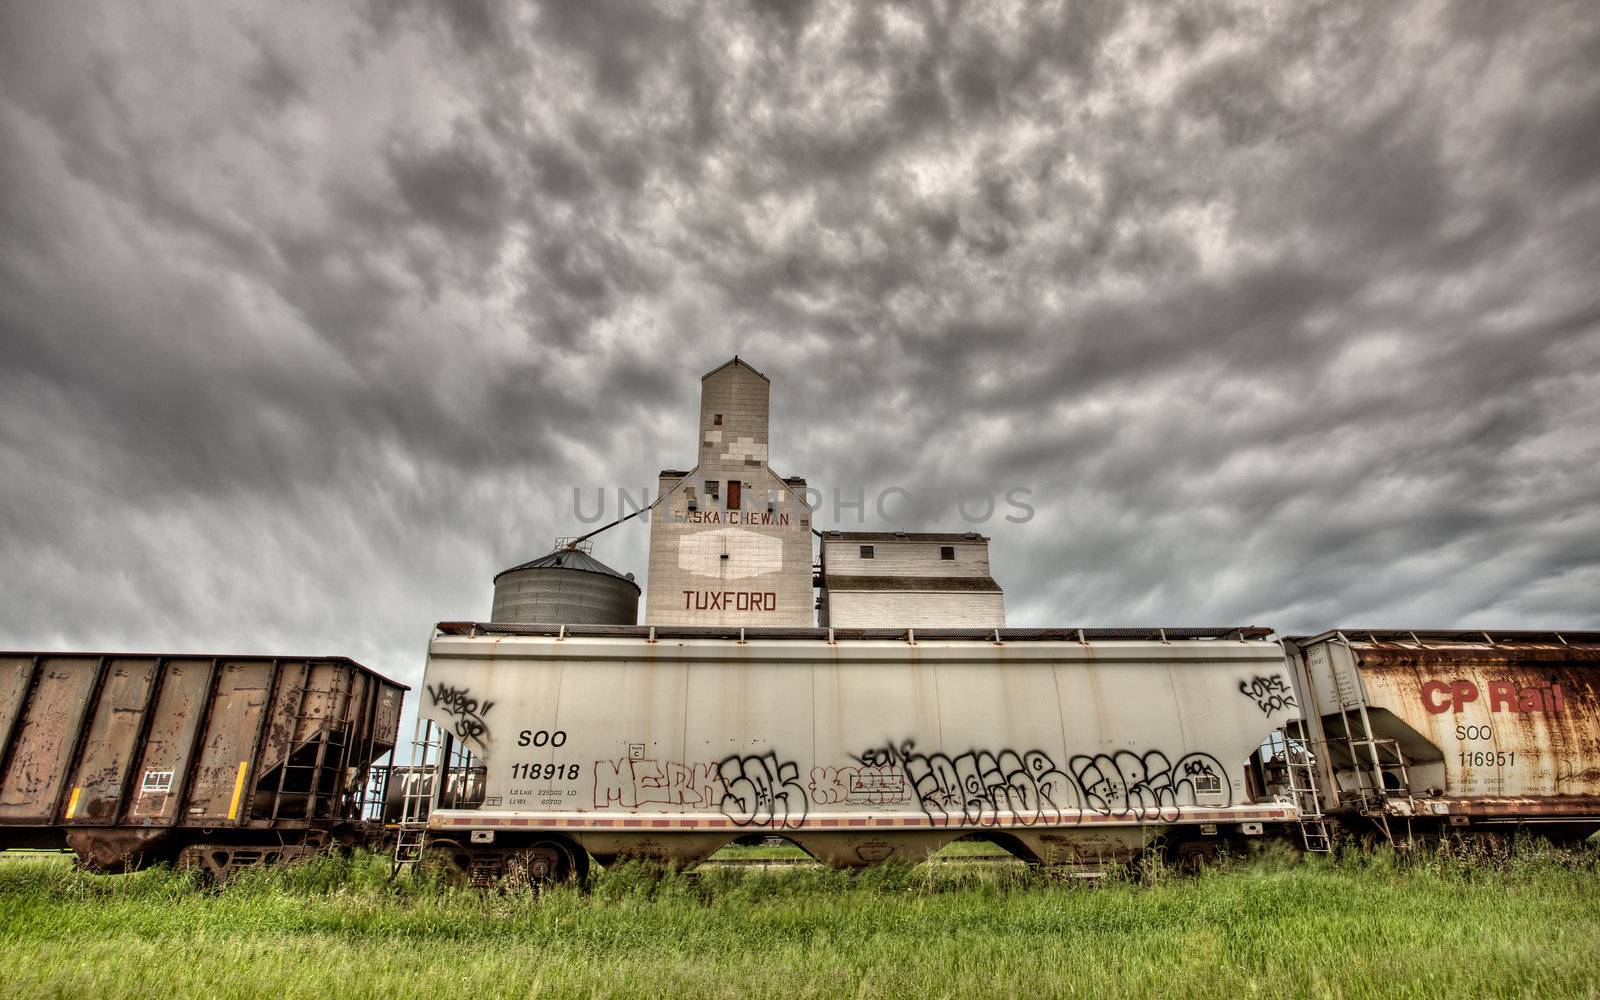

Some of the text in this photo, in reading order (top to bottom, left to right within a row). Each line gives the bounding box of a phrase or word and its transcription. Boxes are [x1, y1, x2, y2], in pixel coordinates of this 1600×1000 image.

[674, 510, 790, 526] SASKATCHEWAN
[683, 590, 776, 611] TUXFORD
[1421, 680, 1565, 714] CP Rail
[517, 730, 567, 748] SOO
[1455, 725, 1493, 741] SOO
[1459, 752, 1515, 767] 116951
[511, 763, 580, 780] 118918
